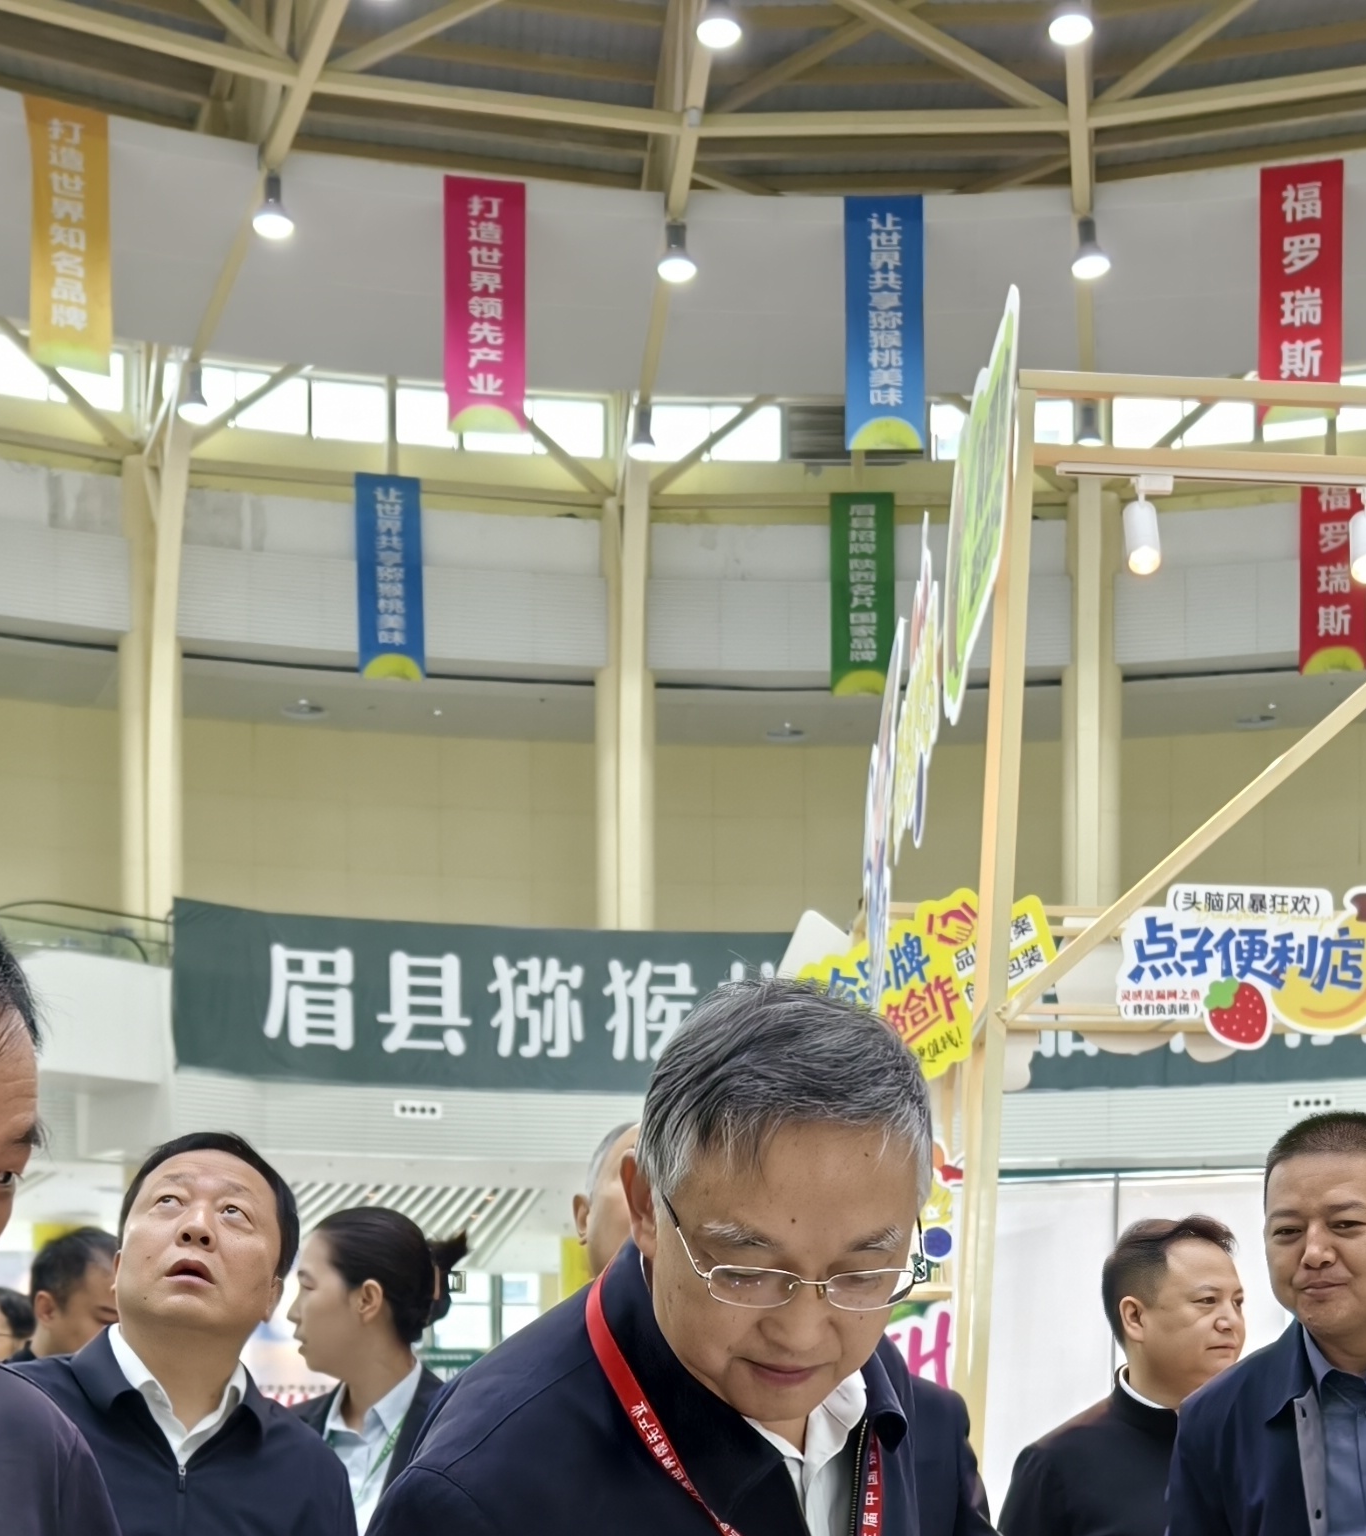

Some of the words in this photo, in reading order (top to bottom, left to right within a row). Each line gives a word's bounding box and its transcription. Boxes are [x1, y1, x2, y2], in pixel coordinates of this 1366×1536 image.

[47, 118, 88, 333] 打造世界知名品牌
[466, 195, 504, 398] 打造世界领先产业
[867, 213, 904, 408] 让世界共享猕猴桃美味
[1280, 182, 1323, 381] 福罗瑞斯
[263, 943, 773, 1062] 眉县猕猴
[1127, 916, 1366, 993] 点子便利店
